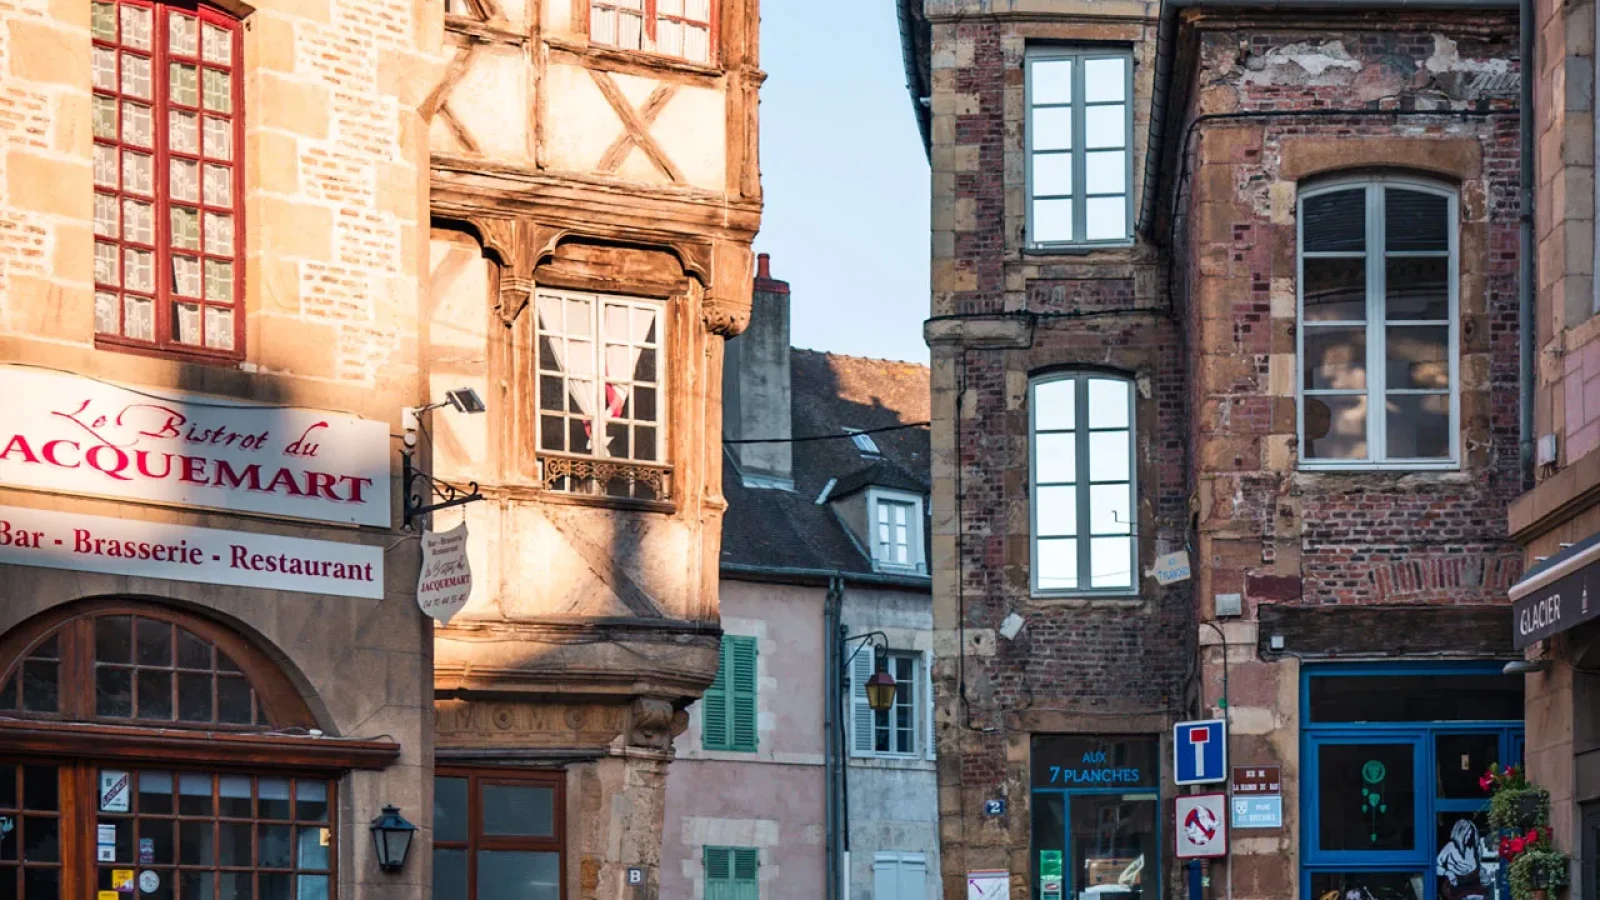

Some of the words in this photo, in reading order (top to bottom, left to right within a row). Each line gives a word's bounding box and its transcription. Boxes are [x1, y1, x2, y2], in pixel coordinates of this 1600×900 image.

[51, 399, 140, 448] Le
[116, 404, 269, 450] Bistrot
[284, 421, 329, 457] du
[0, 520, 45, 549] Bar
[73, 528, 204, 565] Brasserie
[229, 544, 374, 582] Restaurant
[421, 574, 470, 592] JACQUEMART
[1520, 593, 1561, 635] GLACIER
[1082, 751, 1107, 763] AUX
[1049, 765, 1061, 783] 7
[1064, 768, 1140, 783] PLANCHES
[990, 801, 1001, 814] 2
[630, 870, 641, 882] B
